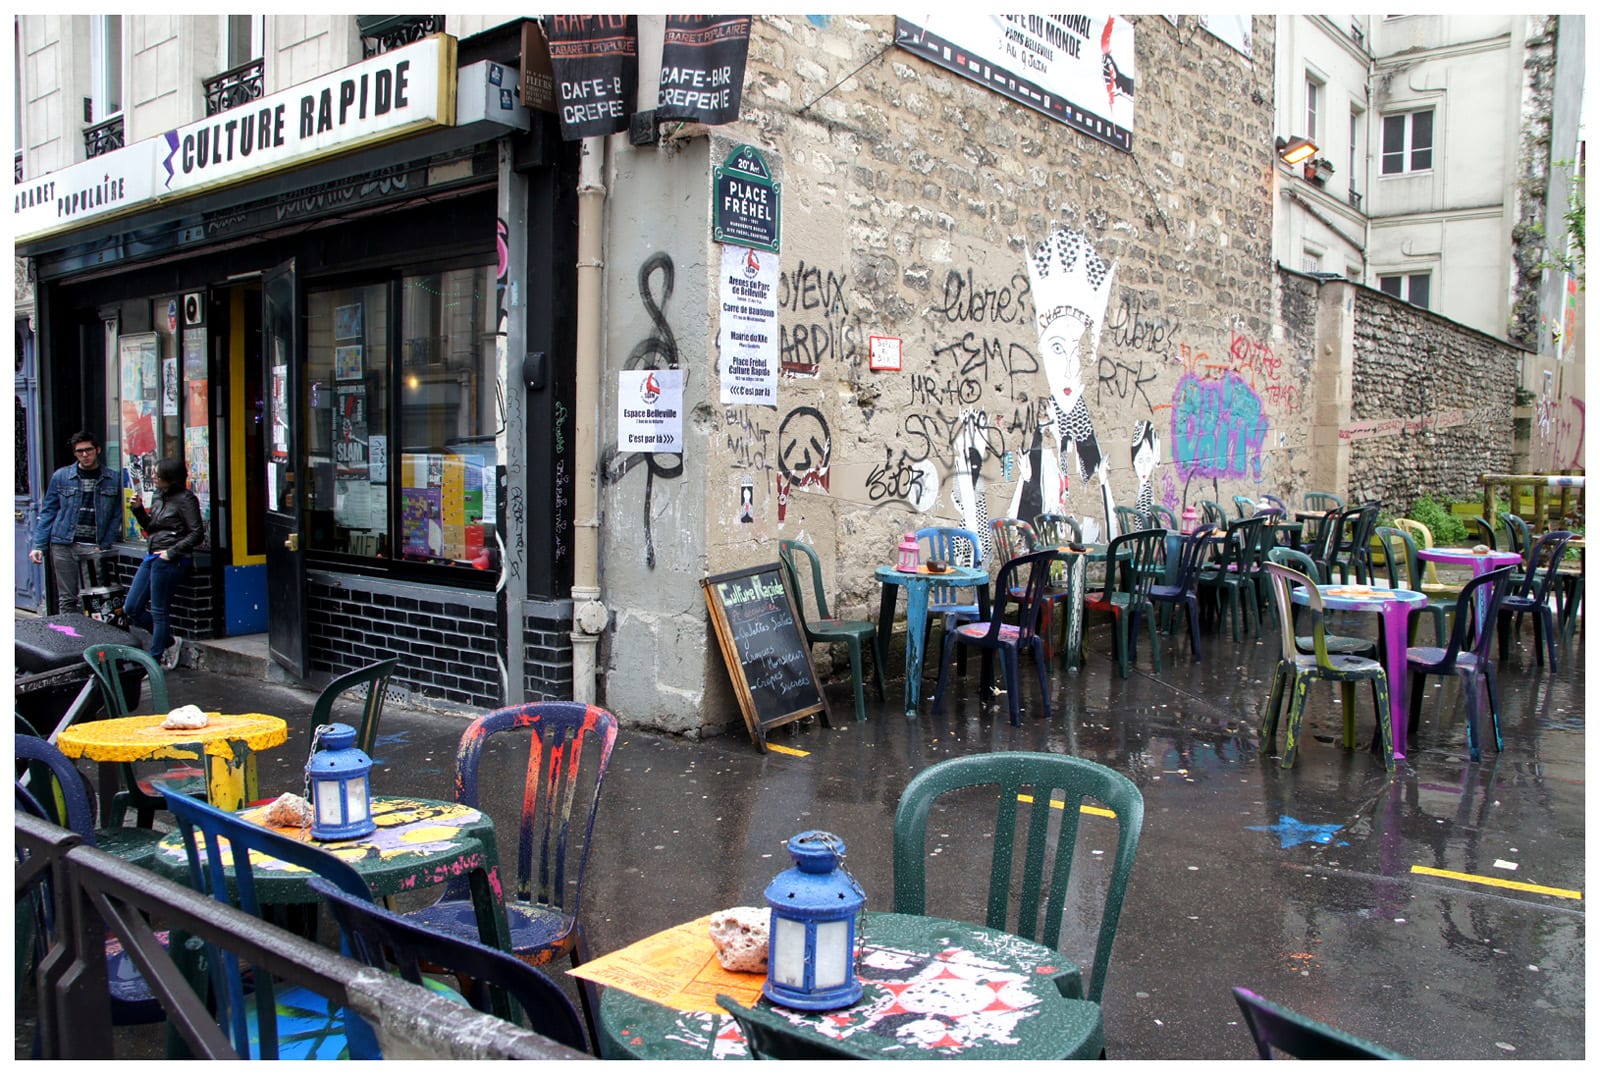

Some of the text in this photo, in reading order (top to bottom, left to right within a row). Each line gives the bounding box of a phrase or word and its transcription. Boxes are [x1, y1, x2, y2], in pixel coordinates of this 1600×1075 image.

[1045, 21, 1081, 59] MONDE
[1024, 37, 1053, 62] BELLEVILLE
[657, 89, 730, 110] CREPERIE
[182, 60, 410, 174] CULTURE RAPIDE
[58, 173, 124, 218] POPULAIRE
[730, 181, 768, 204] PLACE
[725, 196, 771, 221] FRÉHEL
[732, 286, 767, 299] de Belleville
[750, 280, 757, 289] du
[758, 280, 770, 291] Parc
[740, 305, 747, 314] de
[731, 331, 749, 342] Mairie
[750, 333, 757, 342] du
[733, 356, 748, 366] Place
[728, 365, 770, 377] Culture Rapide
[754, 388, 764, 397] par
[624, 408, 677, 418] Espace Belleville
[628, 433, 663, 444] C'est par là
[337, 442, 363, 461] SLAM
[717, 574, 784, 607] Culture Rapide
